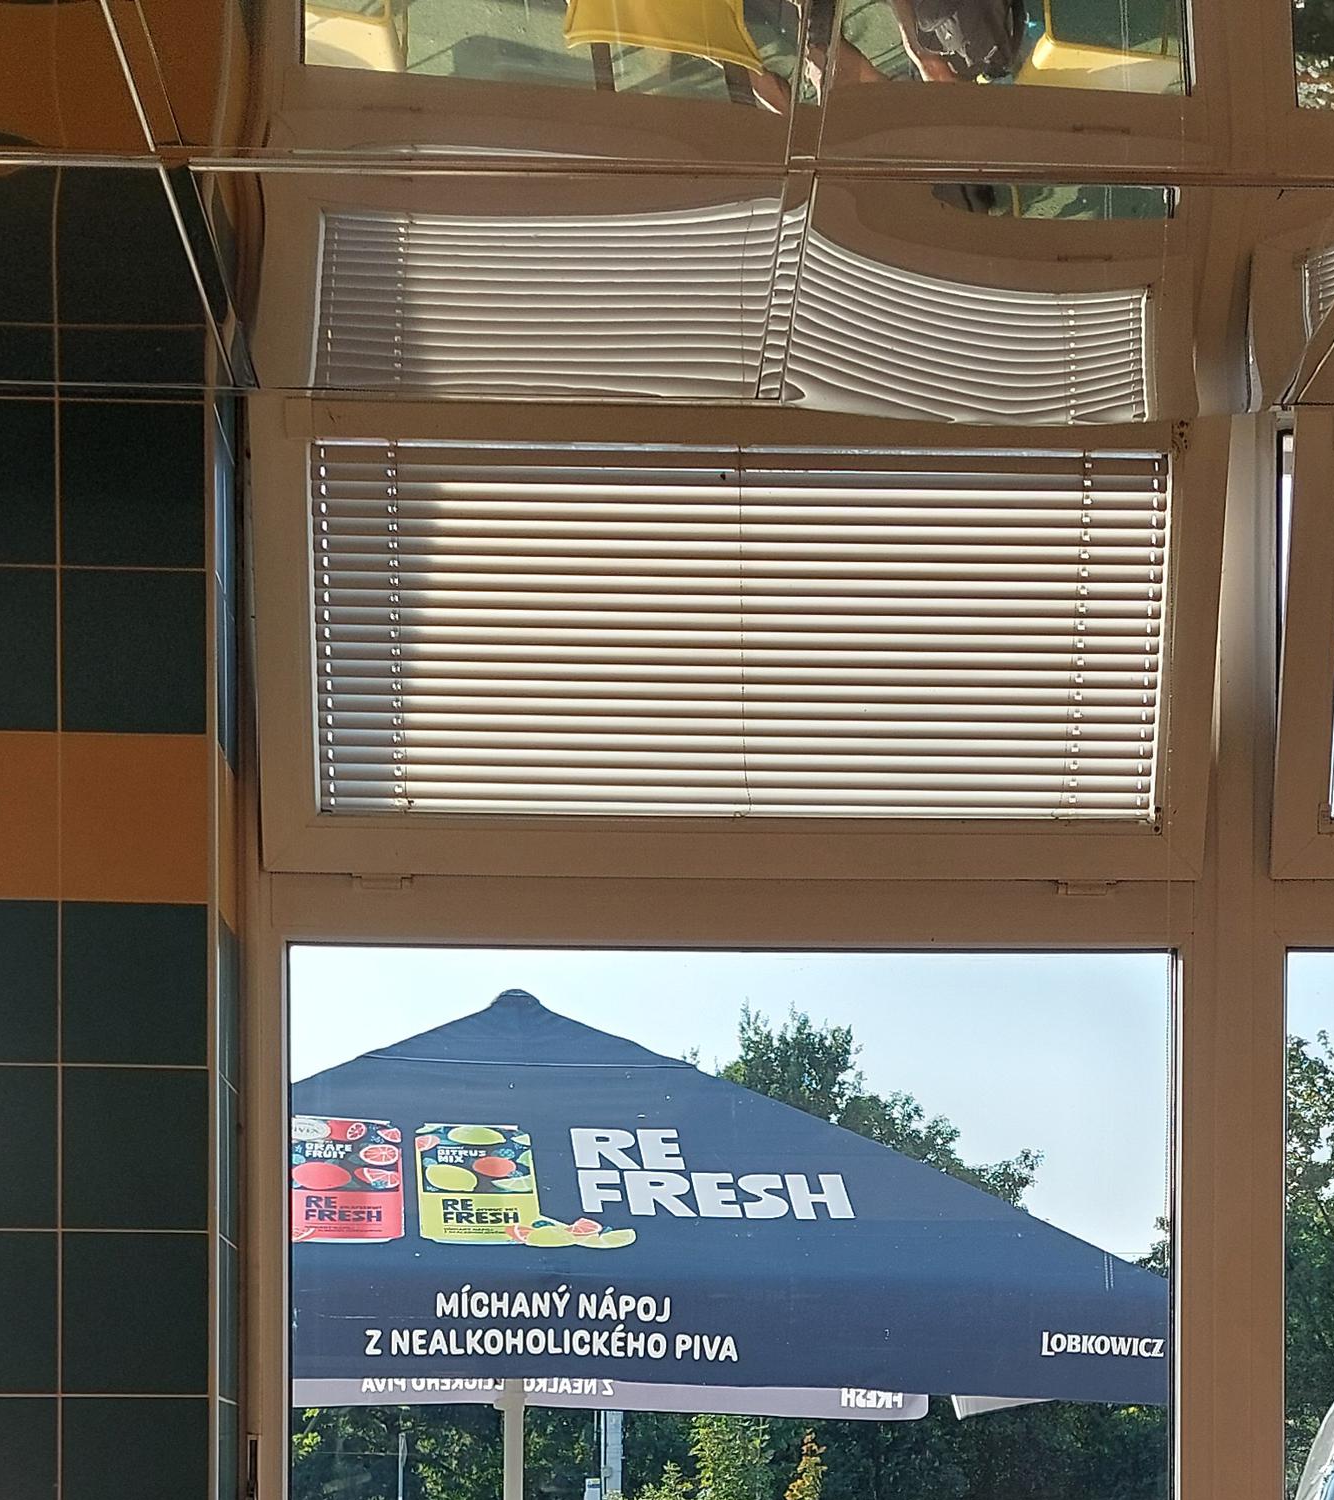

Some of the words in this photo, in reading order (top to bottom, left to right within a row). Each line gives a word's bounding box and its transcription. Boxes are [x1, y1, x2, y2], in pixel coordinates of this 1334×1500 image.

[305, 1150, 347, 1159] FRUIT
[570, 1128, 686, 1170] RE
[305, 1195, 338, 1209] RE
[442, 1198, 474, 1211] RE
[577, 1169, 857, 1220] FRESH
[305, 1209, 383, 1222] FRESH
[443, 1211, 520, 1224] FRESH
[436, 1284, 571, 1319] MÍCHANÝ
[578, 1287, 671, 1322] NÁPOJ
[365, 1329, 382, 1355] Z
[390, 1324, 667, 1358] NEALKOHOLICKÉHO
[675, 1334, 739, 1362] PIVA
[1041, 1331, 1165, 1358] LOBKOWICZ
